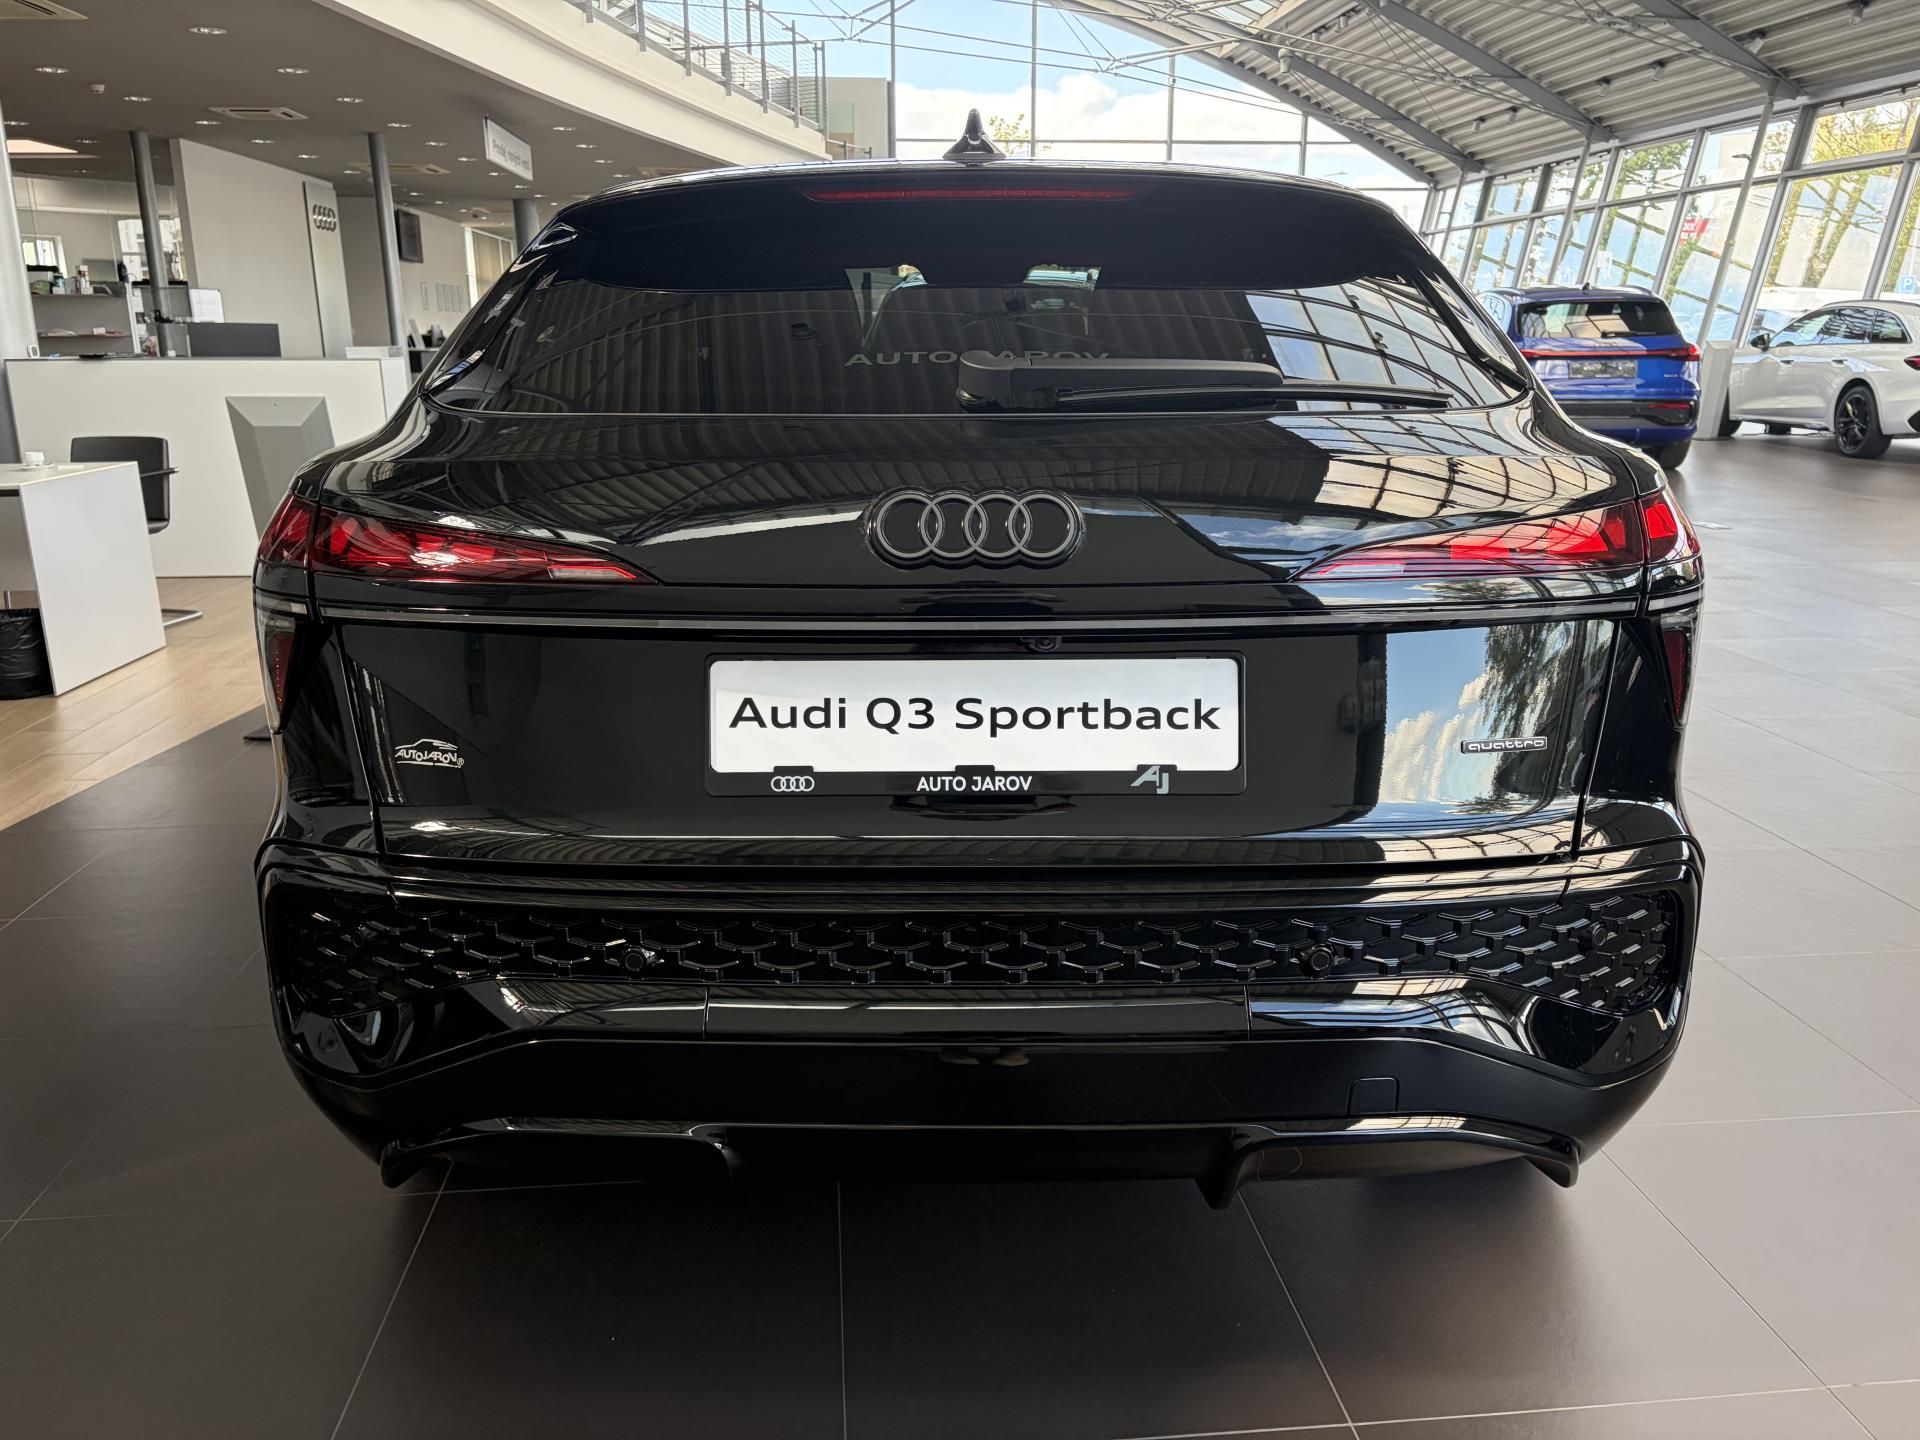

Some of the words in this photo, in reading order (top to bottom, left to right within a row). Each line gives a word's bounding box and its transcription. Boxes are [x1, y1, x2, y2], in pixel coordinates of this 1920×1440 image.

[844, 350, 958, 367] AUTO
[728, 697, 847, 729] Audi
[865, 697, 935, 735] Q3
[955, 697, 1221, 738] Sportback
[1468, 740, 1545, 753] quattro
[916, 776, 967, 792] AUTO
[971, 776, 1033, 792] JAROV
